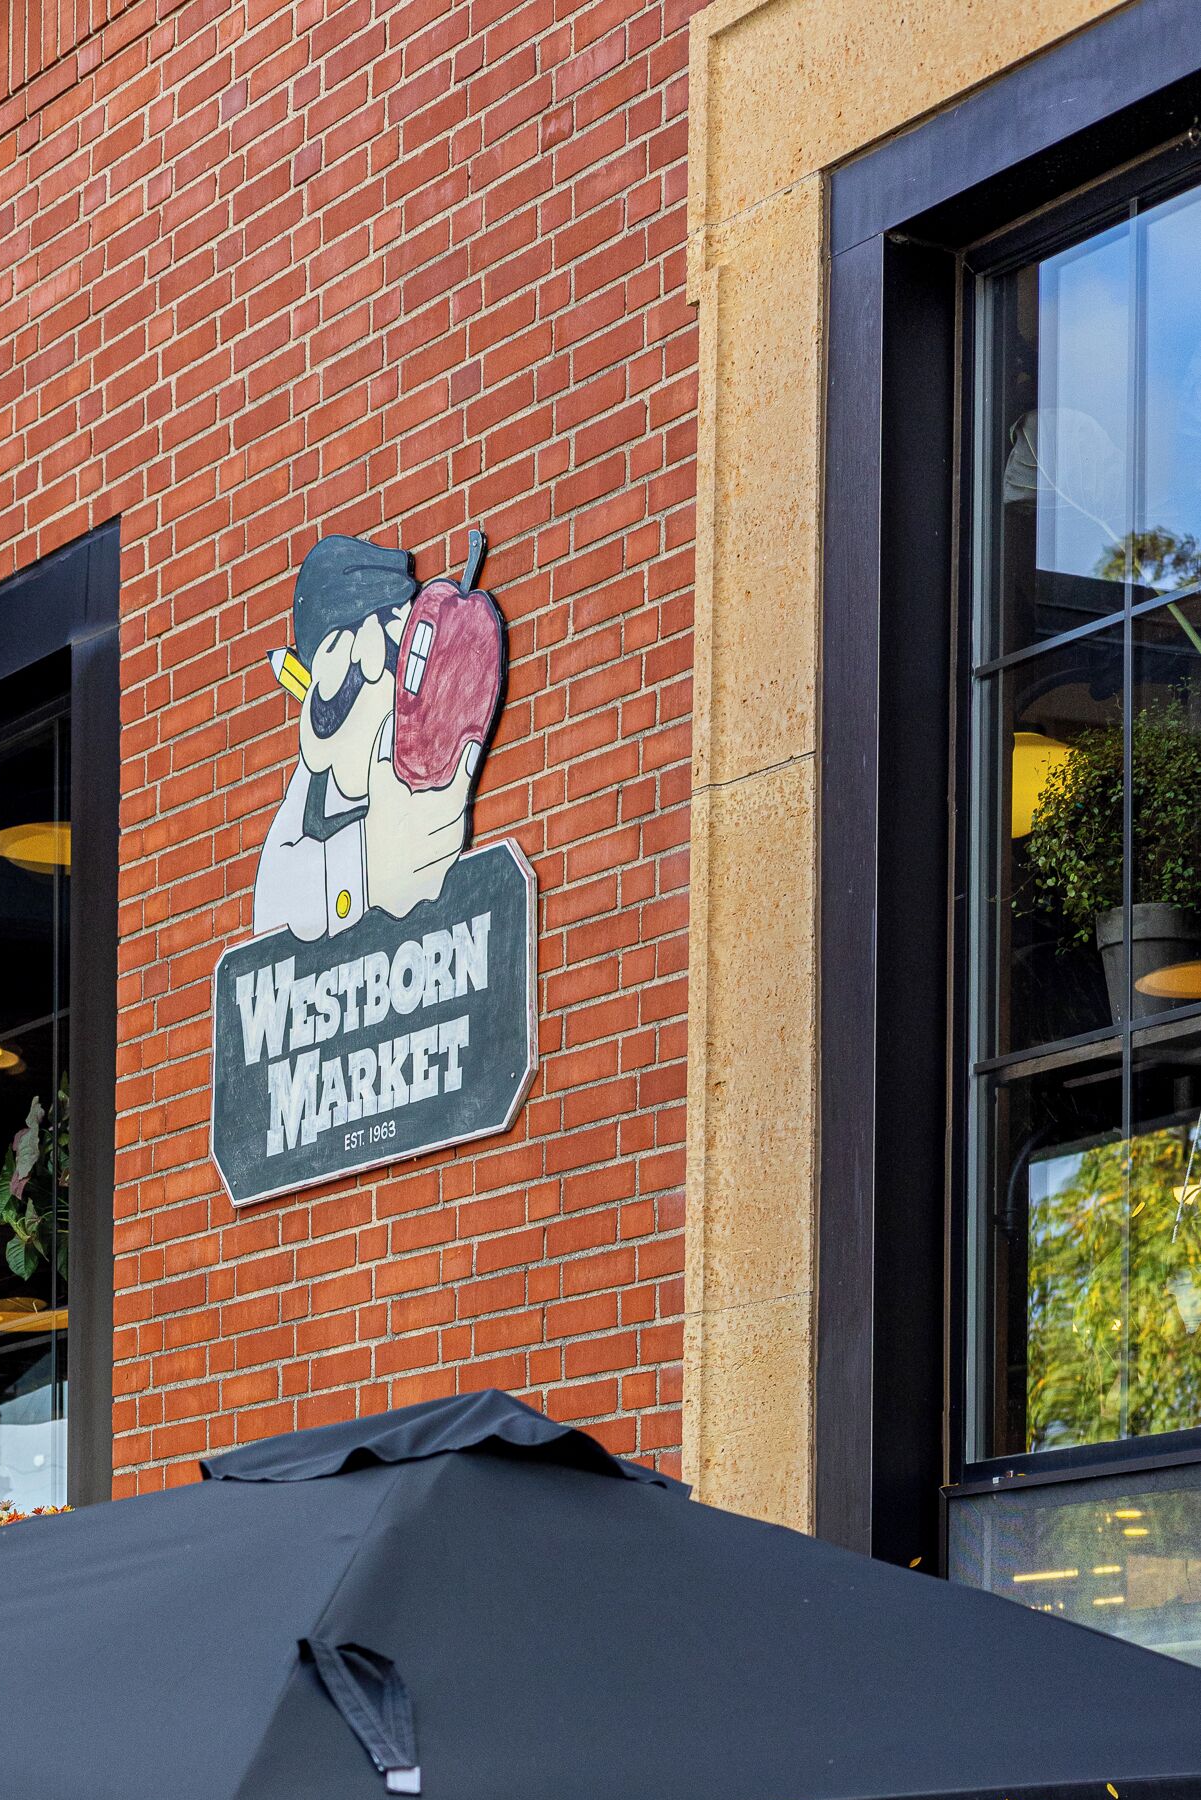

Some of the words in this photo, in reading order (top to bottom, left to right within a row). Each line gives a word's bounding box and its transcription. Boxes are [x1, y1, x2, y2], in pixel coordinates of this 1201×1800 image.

[235, 911, 491, 1066] WESTBORN
[266, 1015, 470, 1157] MARKET
[344, 1131, 365, 1151] EST.
[369, 1120, 396, 1141] 1963
